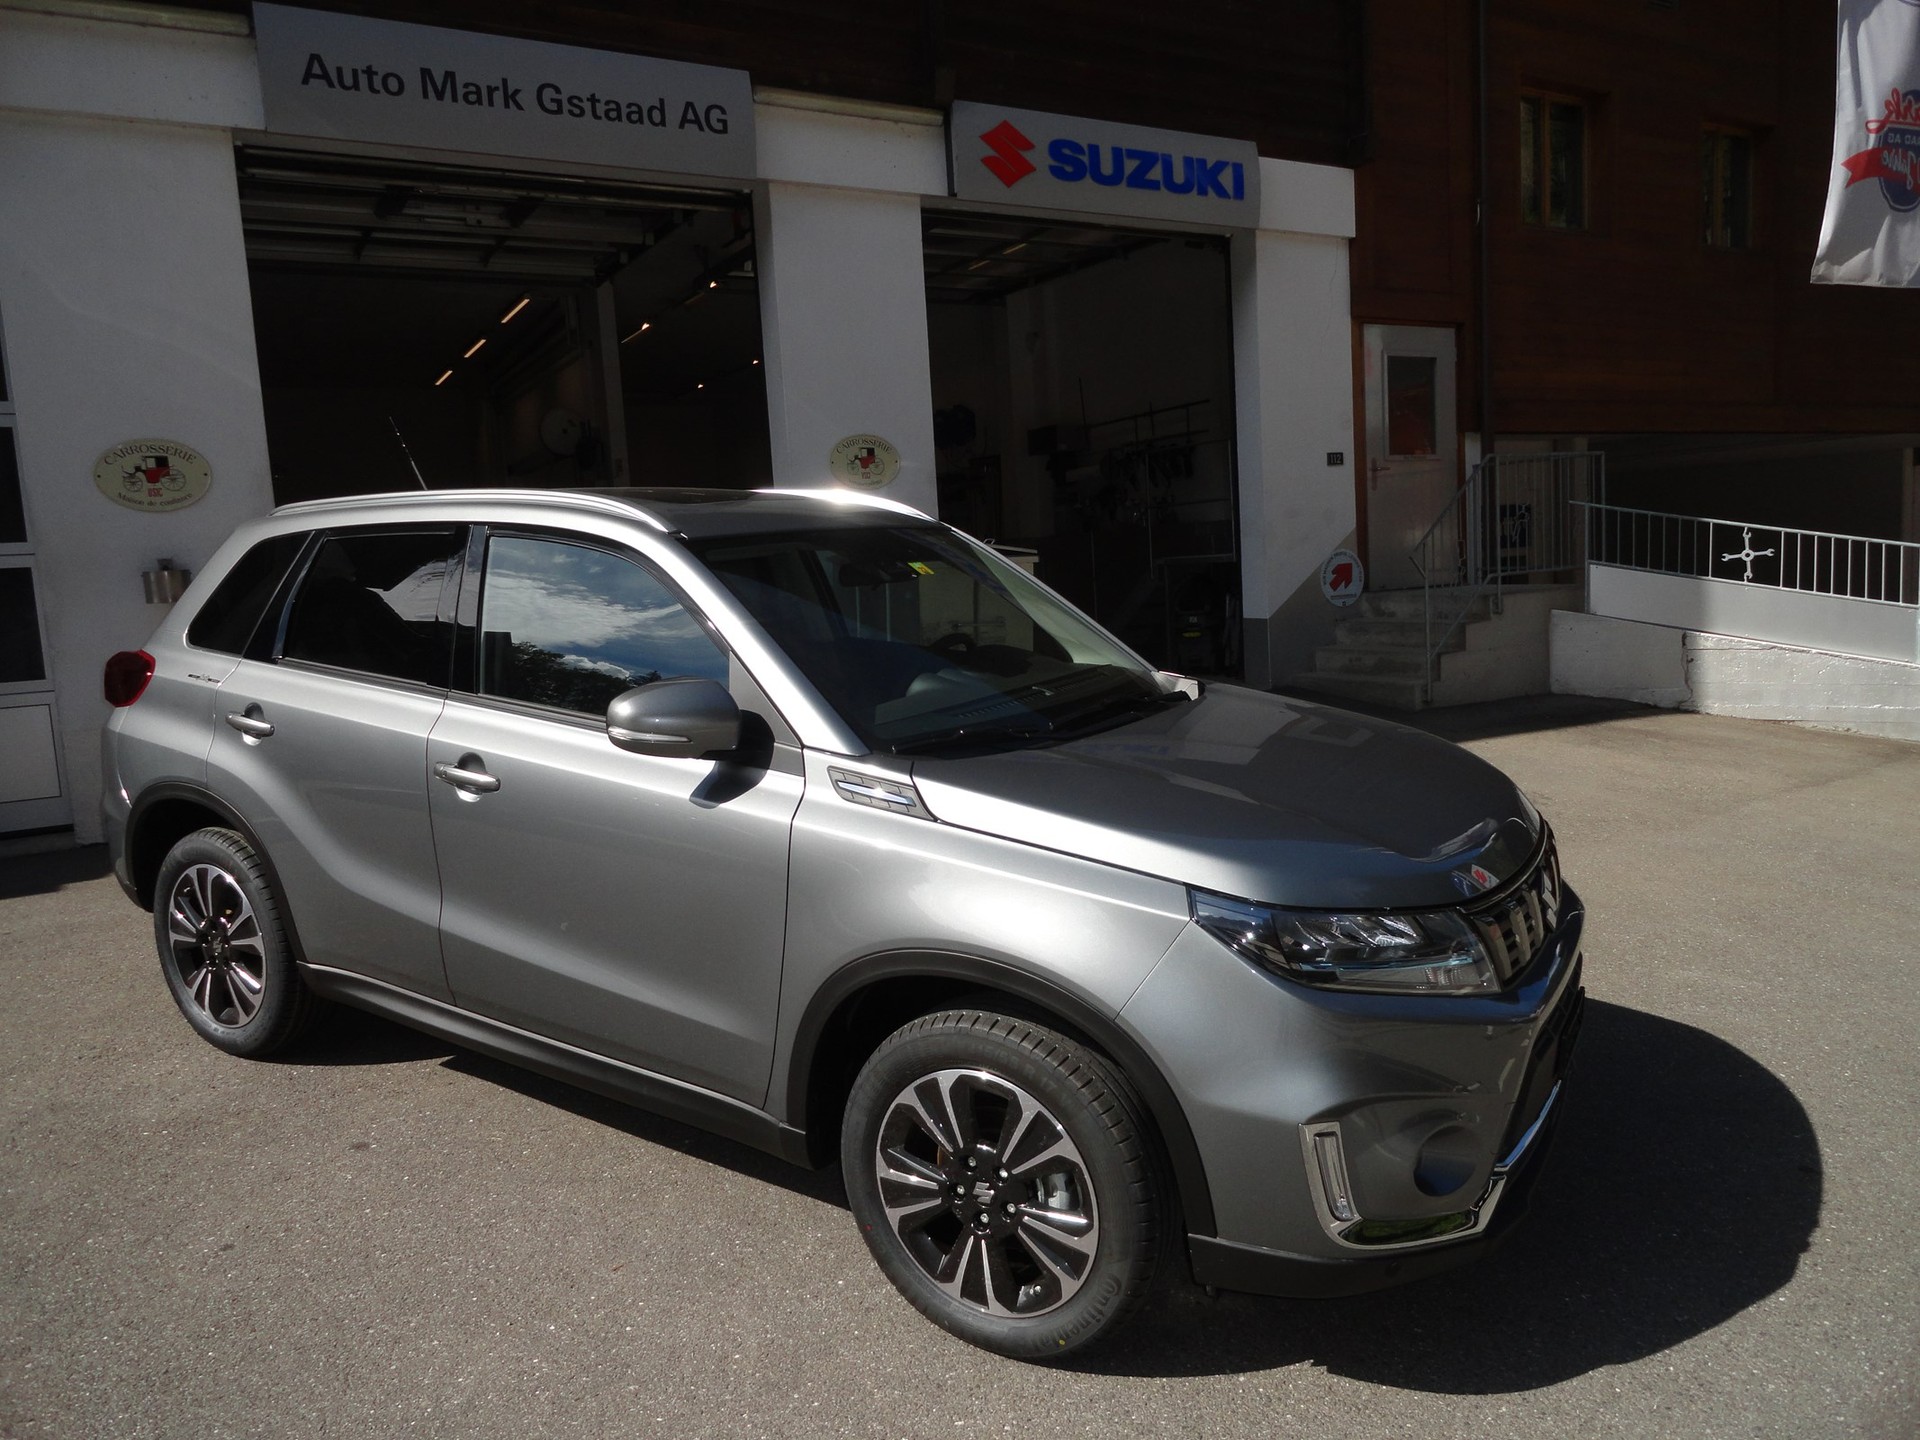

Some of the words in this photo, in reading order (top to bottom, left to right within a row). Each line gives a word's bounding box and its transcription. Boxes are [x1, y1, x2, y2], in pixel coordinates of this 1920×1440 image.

[301, 53, 405, 97] Auto
[420, 66, 526, 112] Mark
[535, 82, 667, 128] Gstaad
[678, 102, 729, 135] AG
[1048, 139, 1244, 200] SUZUKI
[104, 444, 197, 465] CARROSSERIE
[836, 438, 893, 454] CARROSSERIE
[1330, 453, 1342, 464] 112
